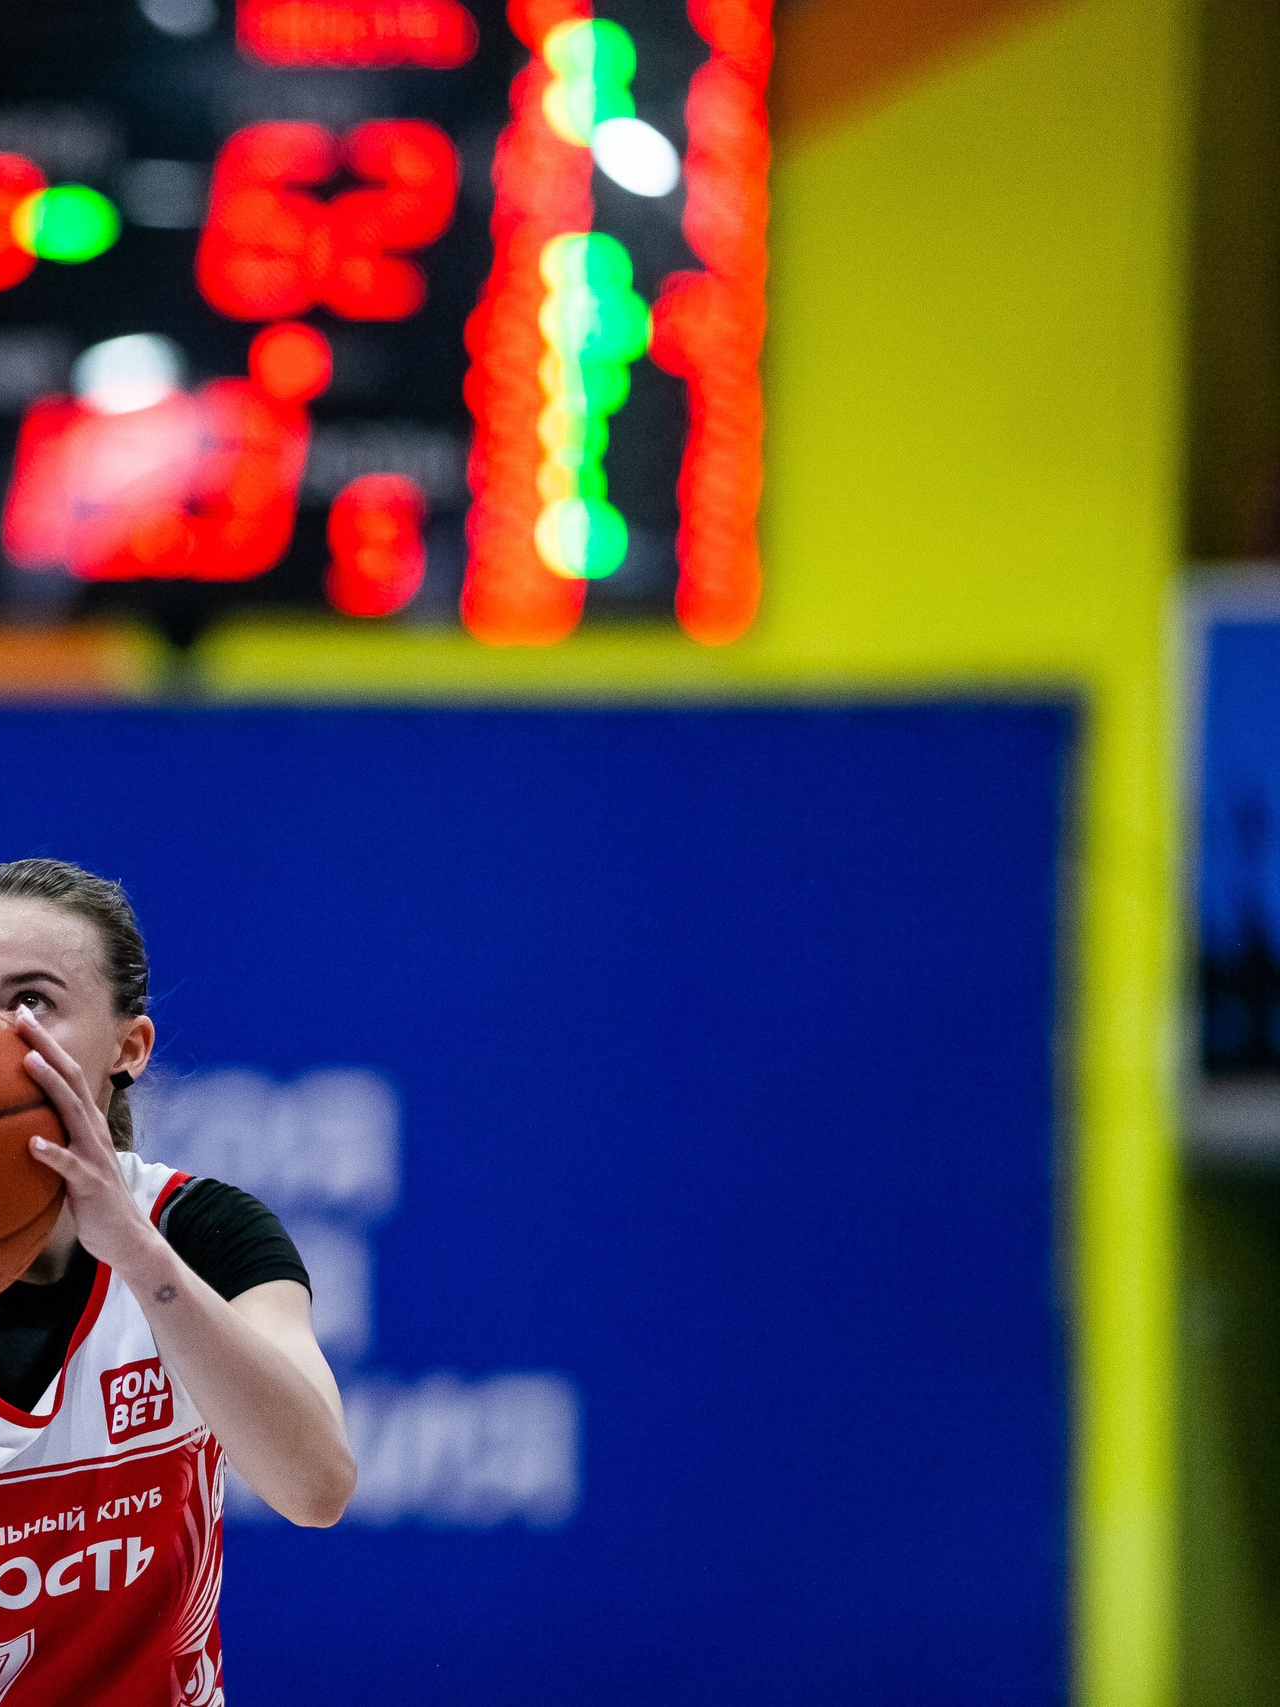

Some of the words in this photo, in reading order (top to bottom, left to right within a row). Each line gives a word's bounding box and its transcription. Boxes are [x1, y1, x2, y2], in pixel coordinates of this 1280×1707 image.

[197, 118, 458, 321] 62
[109, 1365, 166, 1406] FON
[111, 1391, 169, 1435] BET
[96, 1485, 163, 1523] КЛУБ
